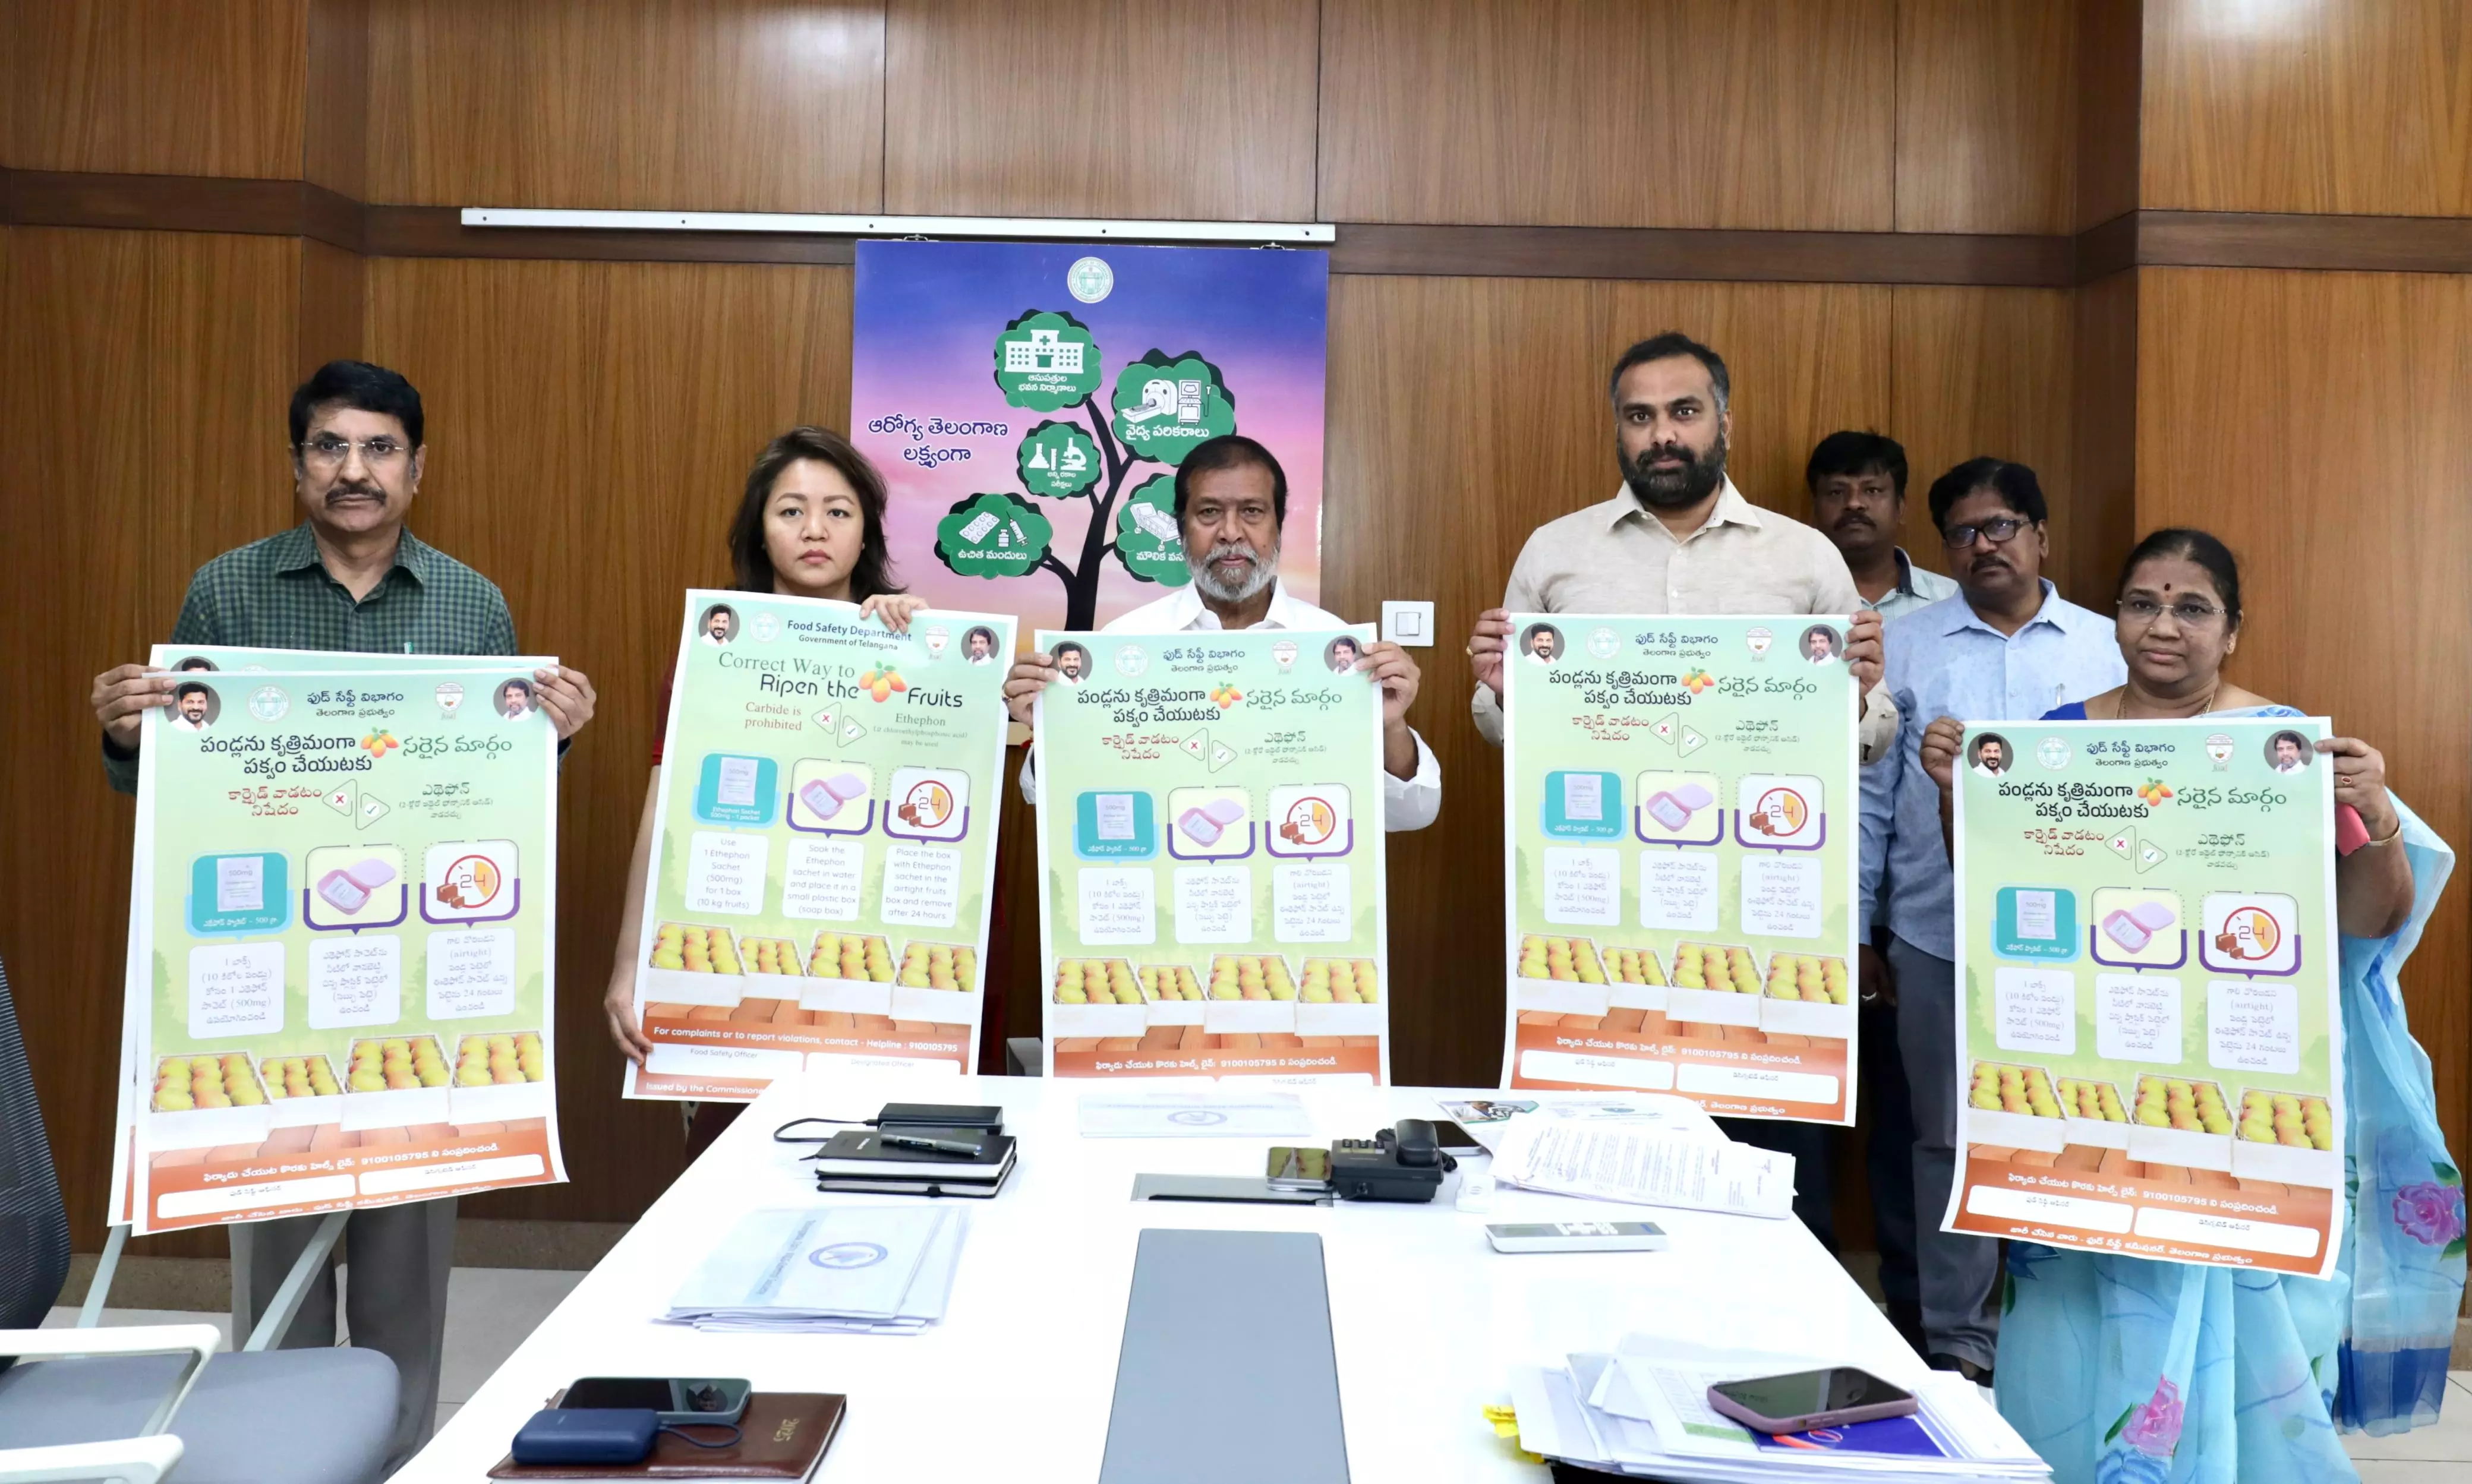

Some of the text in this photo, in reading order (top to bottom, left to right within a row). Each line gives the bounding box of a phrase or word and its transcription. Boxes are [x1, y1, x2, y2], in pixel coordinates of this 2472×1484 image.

[868, 413, 1008, 441] ఆరోగ్య తెలంగాణ
[1125, 424, 1209, 441] వైద్య పరికరాలు
[986, 550, 1027, 560] మందులు
[787, 620, 912, 643] Food Safety Department
[799, 634, 898, 652] Government of Telangana
[1635, 635, 1655, 646] ఫుడ్
[1680, 634, 1718, 645] విభాగం
[1163, 651, 1183, 661] ఫుడ్
[1209, 649, 1245, 659] విభాగం
[1679, 649, 1711, 658] ప్రభుత్వం
[718, 652, 855, 678] Correct Way to
[1171, 664, 1238, 674] తెలంగాణ ప్రభుత్వం
[1550, 670, 1677, 690] పండ్లను కృత్రిమంగా
[761, 674, 963, 708] Ripen the Fruits
[1718, 677, 1817, 701] సరైన మార్గం
[308, 692, 330, 705] ఫుడ్
[361, 691, 403, 703] విభాగం
[1077, 689, 1205, 709] పండ్లను కృత్రిమంగా
[1247, 689, 1342, 711] సరైన మార్గం
[1584, 691, 1692, 709] పక్వం చేయుటకు
[316, 707, 395, 718] తెలంగాణ ప్రభుత్వం
[746, 702, 802, 716] Carbide is
[745, 716, 802, 733] prohibited
[896, 713, 946, 727] Ethephon
[1114, 708, 1221, 728] పక్వం చేయుటకు
[1608, 715, 1649, 728] వాడటం
[201, 734, 355, 757] పండ్లను కృత్రిమంగా
[1138, 733, 1179, 745] వాడటం
[403, 734, 512, 759] సరైన మార్గం
[2086, 743, 2107, 754] ఫుడ్
[2135, 742, 2175, 753] విభాగం
[244, 755, 371, 779] పక్వం చేయుటకు
[2134, 759, 2168, 768] ప్రభుత్వం
[273, 785, 322, 800] వాడటం
[1999, 782, 2132, 802] పండ్లను కృత్రిమంగా
[918, 797, 941, 810] 24
[2177, 788, 2286, 812] సరైన మార్గం
[1771, 805, 1793, 818] 24
[2036, 803, 2149, 822] పక్వం చేయుటకు
[1300, 813, 1322, 827] 24
[2061, 829, 2104, 841] వాడటం
[710, 850, 750, 859] Ethephon
[809, 844, 828, 852] Soak
[896, 848, 918, 856] Place
[937, 851, 951, 859] box
[712, 862, 740, 871] Sachet
[806, 856, 845, 866] Ethephon
[913, 861, 951, 871] Ethephon
[460, 874, 485, 888] 24
[707, 874, 743, 885] (500mg)
[894, 885, 946, 895] airtight fruits
[711, 899, 722, 908] kg
[812, 894, 838, 902] plastic
[921, 899, 952, 908] remove
[799, 905, 843, 915] (soap box)
[2238, 926, 2265, 940] 24
[654, 1027, 669, 1035] For
[671, 1028, 720, 1038] complaints
[747, 1033, 775, 1042] report
[778, 1034, 822, 1045] violations,
[825, 1038, 858, 1046] contact
[866, 1039, 901, 1049] Helpline
[909, 1042, 958, 1052] 9100105795
[710, 1050, 732, 1059] Safety
[1682, 1047, 1738, 1059] 9100105795
[1221, 1059, 1276, 1068] 9100105795
[646, 1082, 673, 1091] Issued
[676, 1083, 687, 1093] by
[1711, 1103, 1747, 1112] తెలంగాణ
[361, 1151, 428, 1165] 9100105795
[2143, 1191, 2207, 1205] 9100105795
